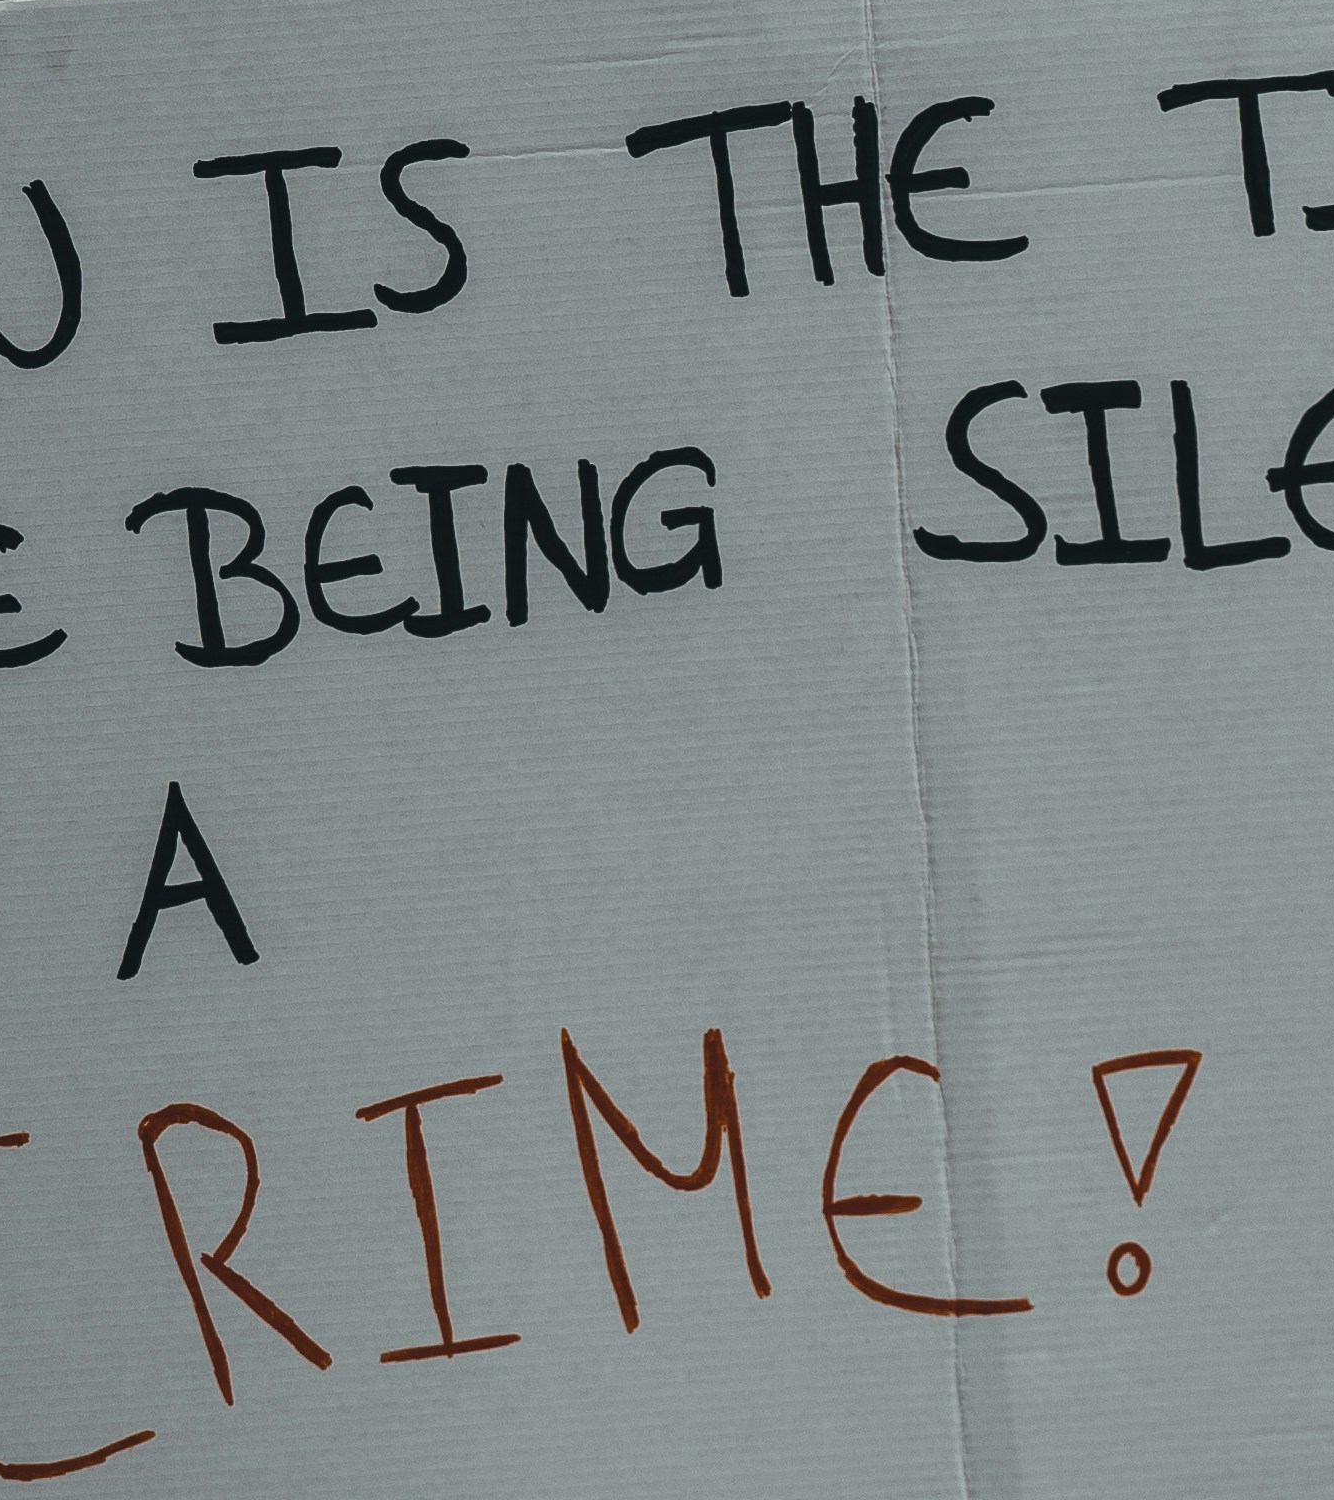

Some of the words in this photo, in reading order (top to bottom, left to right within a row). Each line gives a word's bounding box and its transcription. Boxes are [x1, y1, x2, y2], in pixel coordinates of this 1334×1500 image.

[193, 139, 470, 344] IS
[625, 96, 1029, 297] THE
[125, 447, 722, 668] BEING
[117, 781, 259, 980] A
